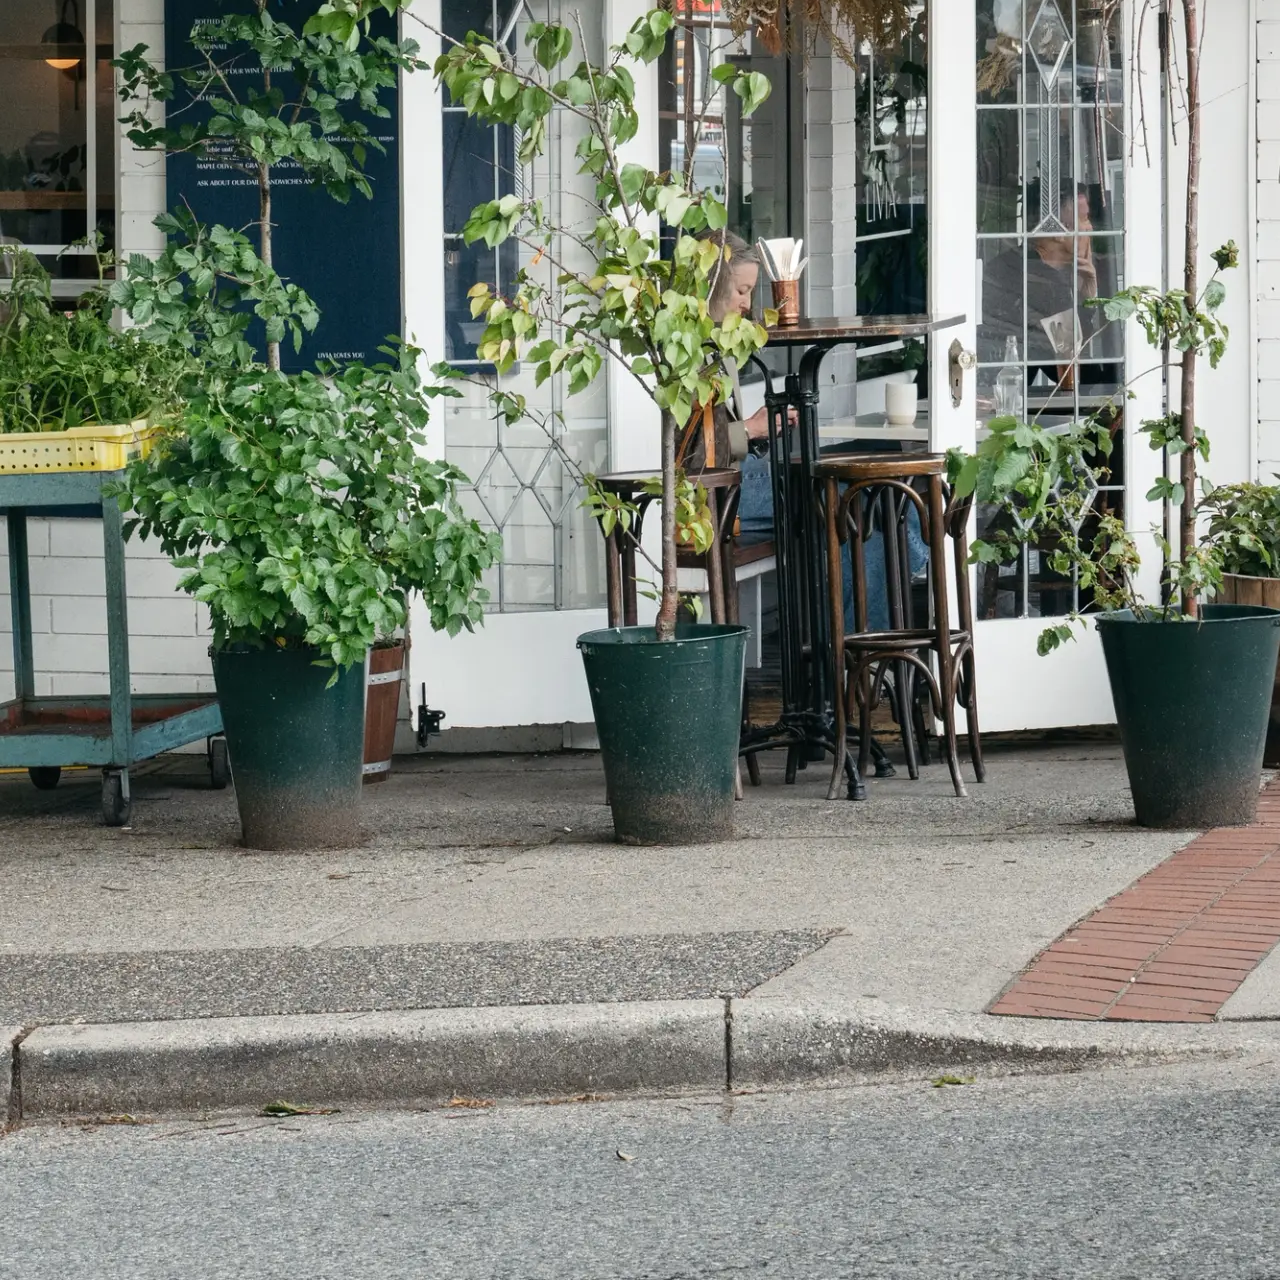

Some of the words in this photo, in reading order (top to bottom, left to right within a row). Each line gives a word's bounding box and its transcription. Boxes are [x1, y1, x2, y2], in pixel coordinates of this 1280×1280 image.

[196, 179, 209, 187] ASK
[267, 178, 303, 186] ANDWICHES
[317, 351, 334, 360] LIVIA
[334, 351, 352, 359] LOVES
[352, 351, 366, 359] YOU
